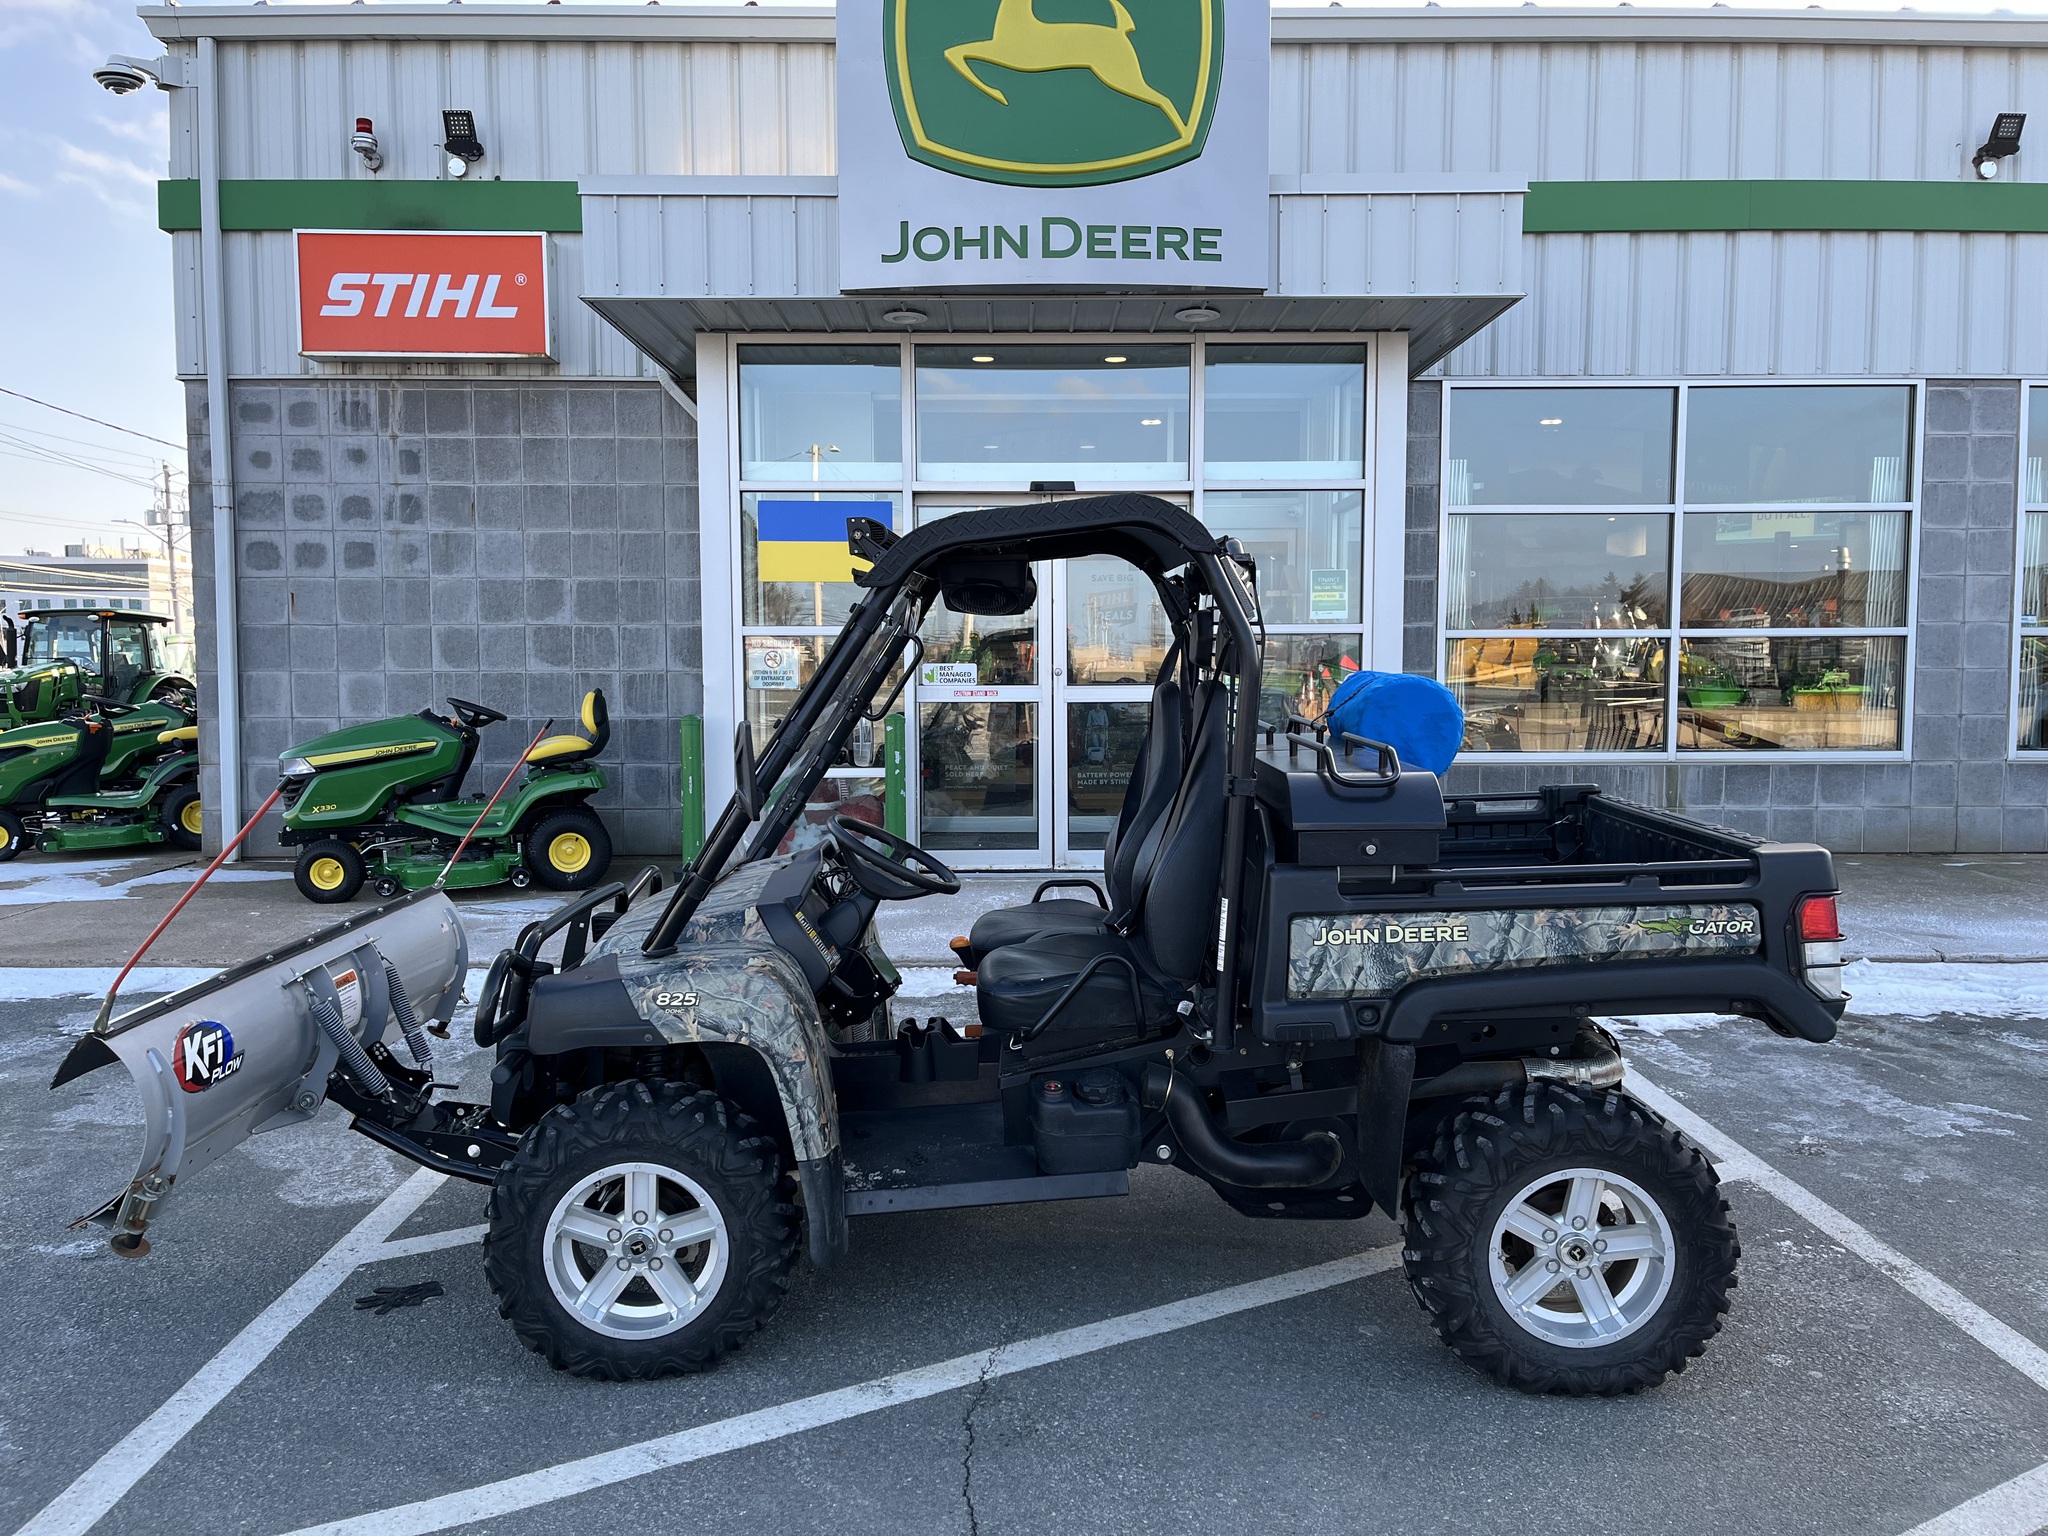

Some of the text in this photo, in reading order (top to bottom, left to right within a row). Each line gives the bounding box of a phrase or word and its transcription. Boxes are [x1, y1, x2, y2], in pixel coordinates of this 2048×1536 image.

[881, 216, 1222, 263] JOHN DEERE
[1091, 574, 1133, 582] SAVE BIG
[1097, 609, 1133, 621] DEALS
[53, 735, 74, 743] DEERE
[374, 744, 418, 756] JOHN DEERE
[312, 804, 337, 814] X330
[1313, 924, 1469, 946] JOHN DEERE
[1689, 919, 1754, 935] GATOR
[655, 991, 701, 1007] 825i
[183, 1029, 224, 1081] KFi
[210, 1054, 243, 1084] PLOW
